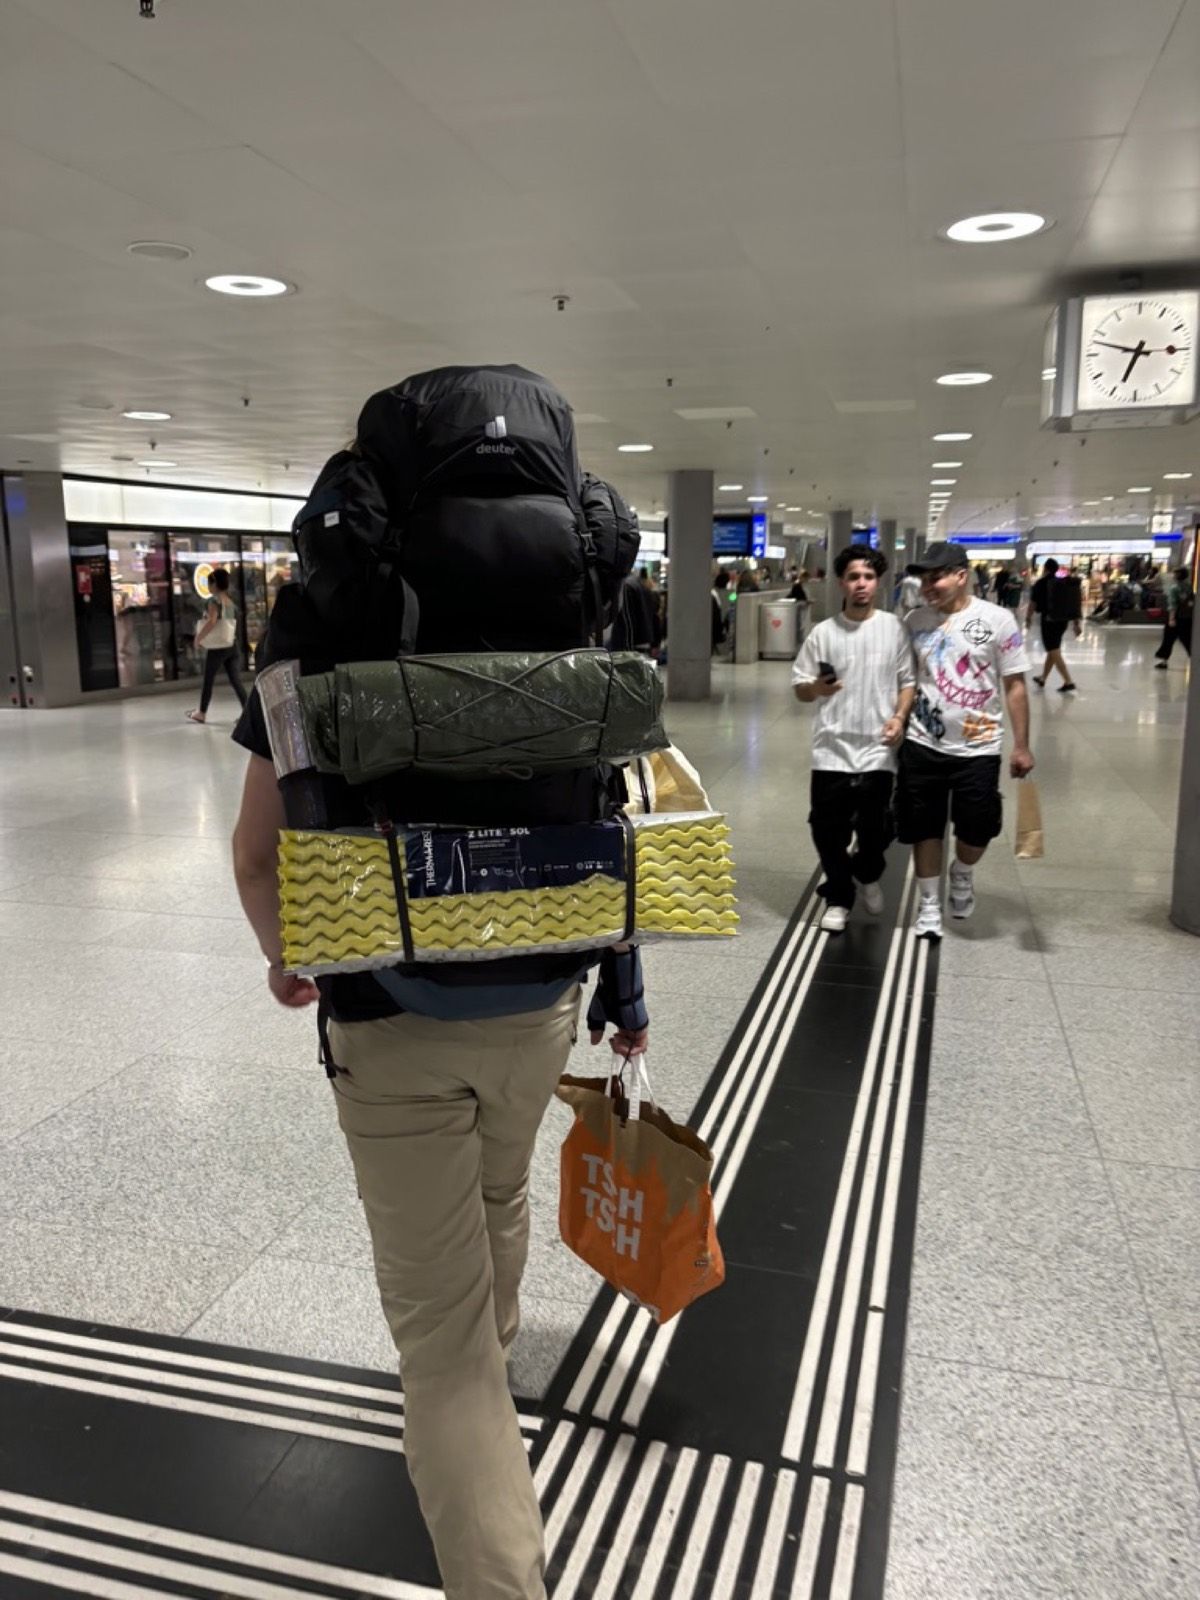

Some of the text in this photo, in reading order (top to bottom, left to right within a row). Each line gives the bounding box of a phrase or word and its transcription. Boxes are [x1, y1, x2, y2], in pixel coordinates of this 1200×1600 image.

[475, 442, 517, 455] deuter
[467, 830, 475, 838] Z
[509, 827, 531, 836] SOL
